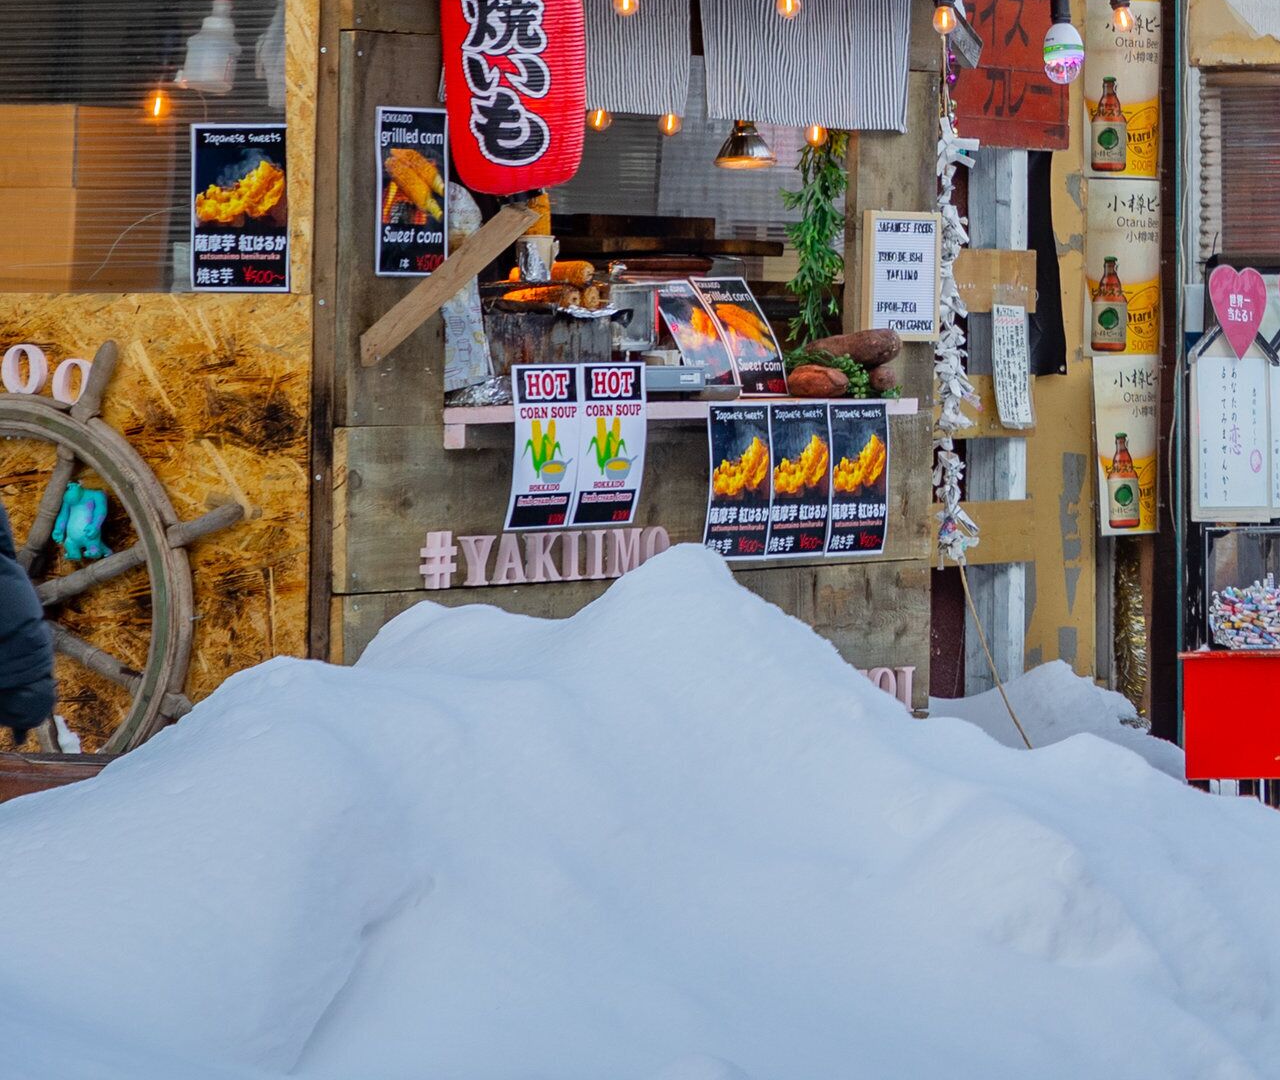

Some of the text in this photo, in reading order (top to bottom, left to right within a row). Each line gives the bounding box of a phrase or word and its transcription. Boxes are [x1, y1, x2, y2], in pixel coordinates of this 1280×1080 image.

[1115, 37, 1145, 48] Otaru
[982, 68, 1054, 117] カレー
[203, 132, 246, 145] Japanese
[420, 131, 444, 145] corn
[1117, 217, 1146, 228] Otaru
[383, 225, 443, 243] Sweet corn
[196, 267, 234, 285] 焼き芋
[1229, 294, 1251, 308] 世界一
[738, 358, 781, 372] Sweet corn
[526, 372, 568, 397] HOT
[592, 370, 633, 395] HOT
[520, 406, 577, 419] CORN SOUP
[586, 404, 642, 417] CORN SOUP
